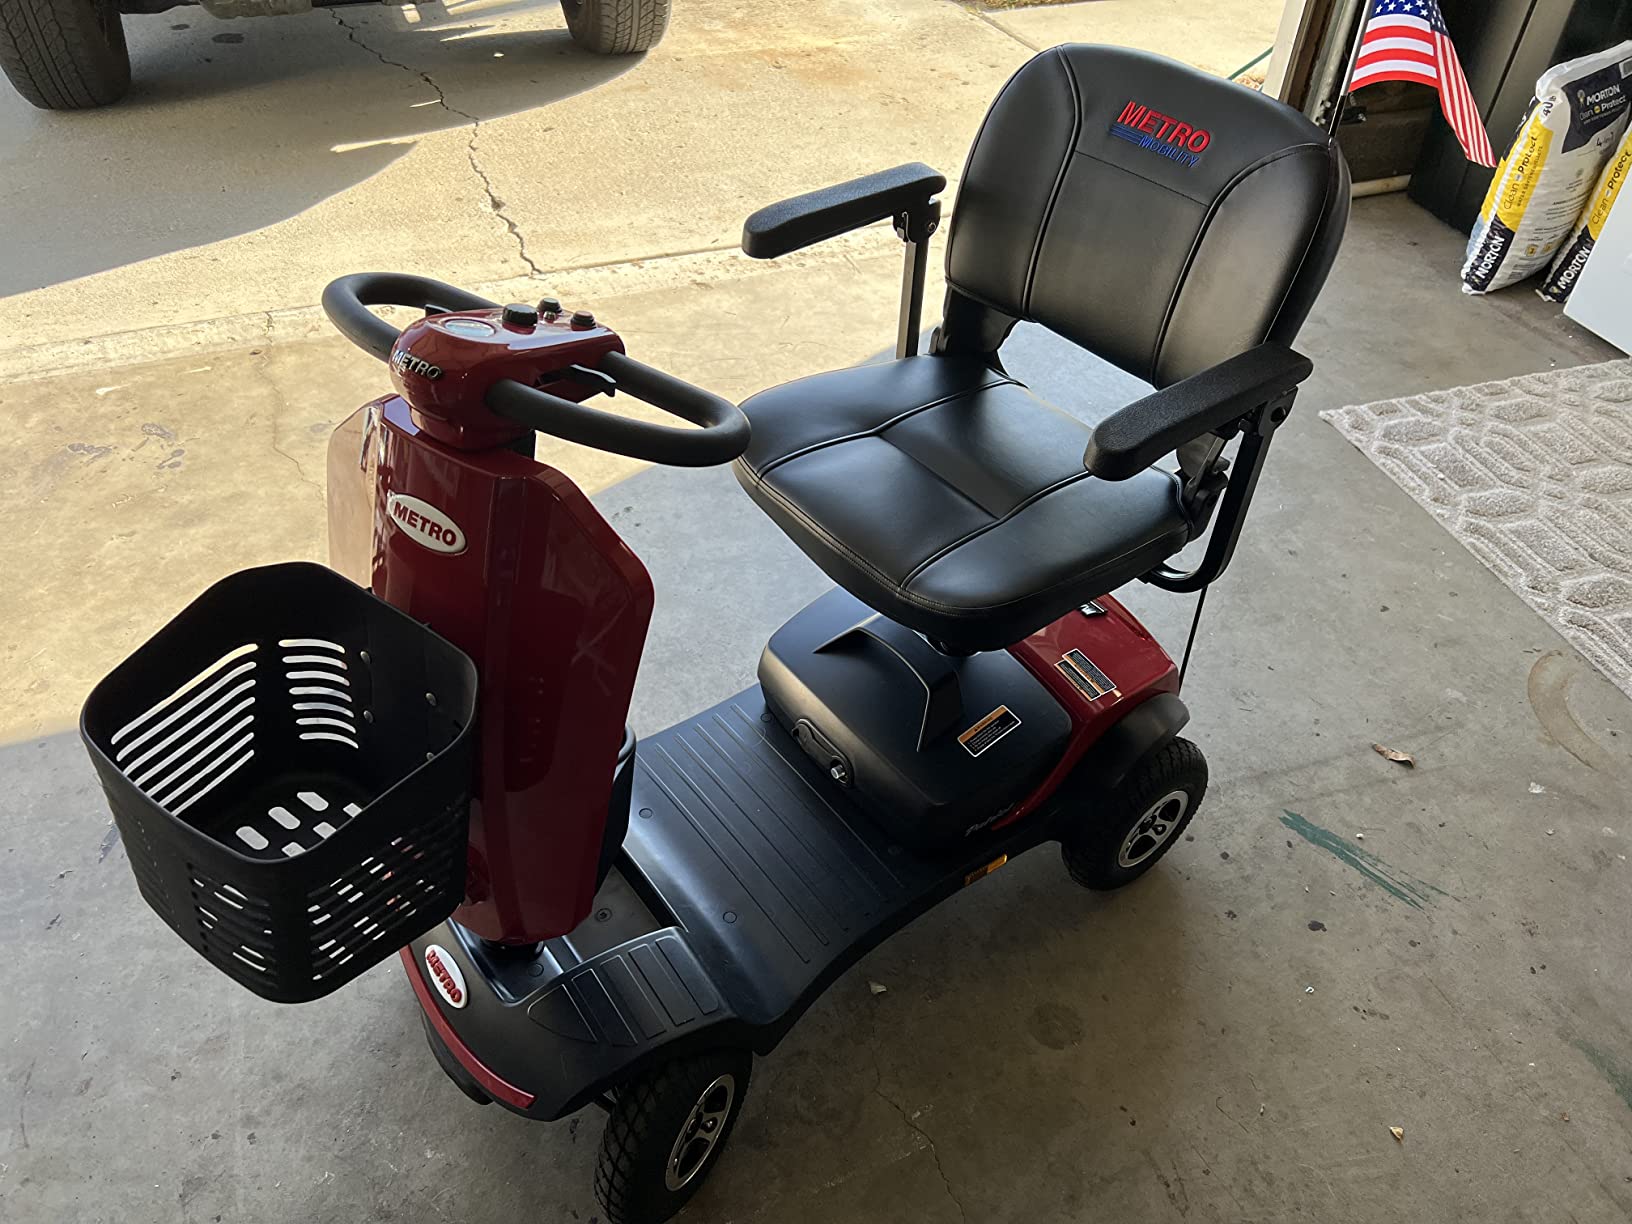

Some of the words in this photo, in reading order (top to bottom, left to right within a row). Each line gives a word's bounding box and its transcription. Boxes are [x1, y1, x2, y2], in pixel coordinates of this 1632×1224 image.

[1586, 84, 1621, 106] MORTON
[1601, 95, 1627, 112] Protect
[1117, 101, 1211, 152] METRO
[1138, 135, 1200, 168] MOBILITY
[1503, 183, 1520, 210] Clean
[1517, 136, 1538, 174] Protect
[1591, 198, 1609, 225] Clean
[1607, 150, 1632, 190] Protect
[1557, 246, 1591, 290] MORTON
[392, 349, 442, 379] METRO
[394, 502, 457, 546] METRO
[426, 950, 462, 1003] METRO
